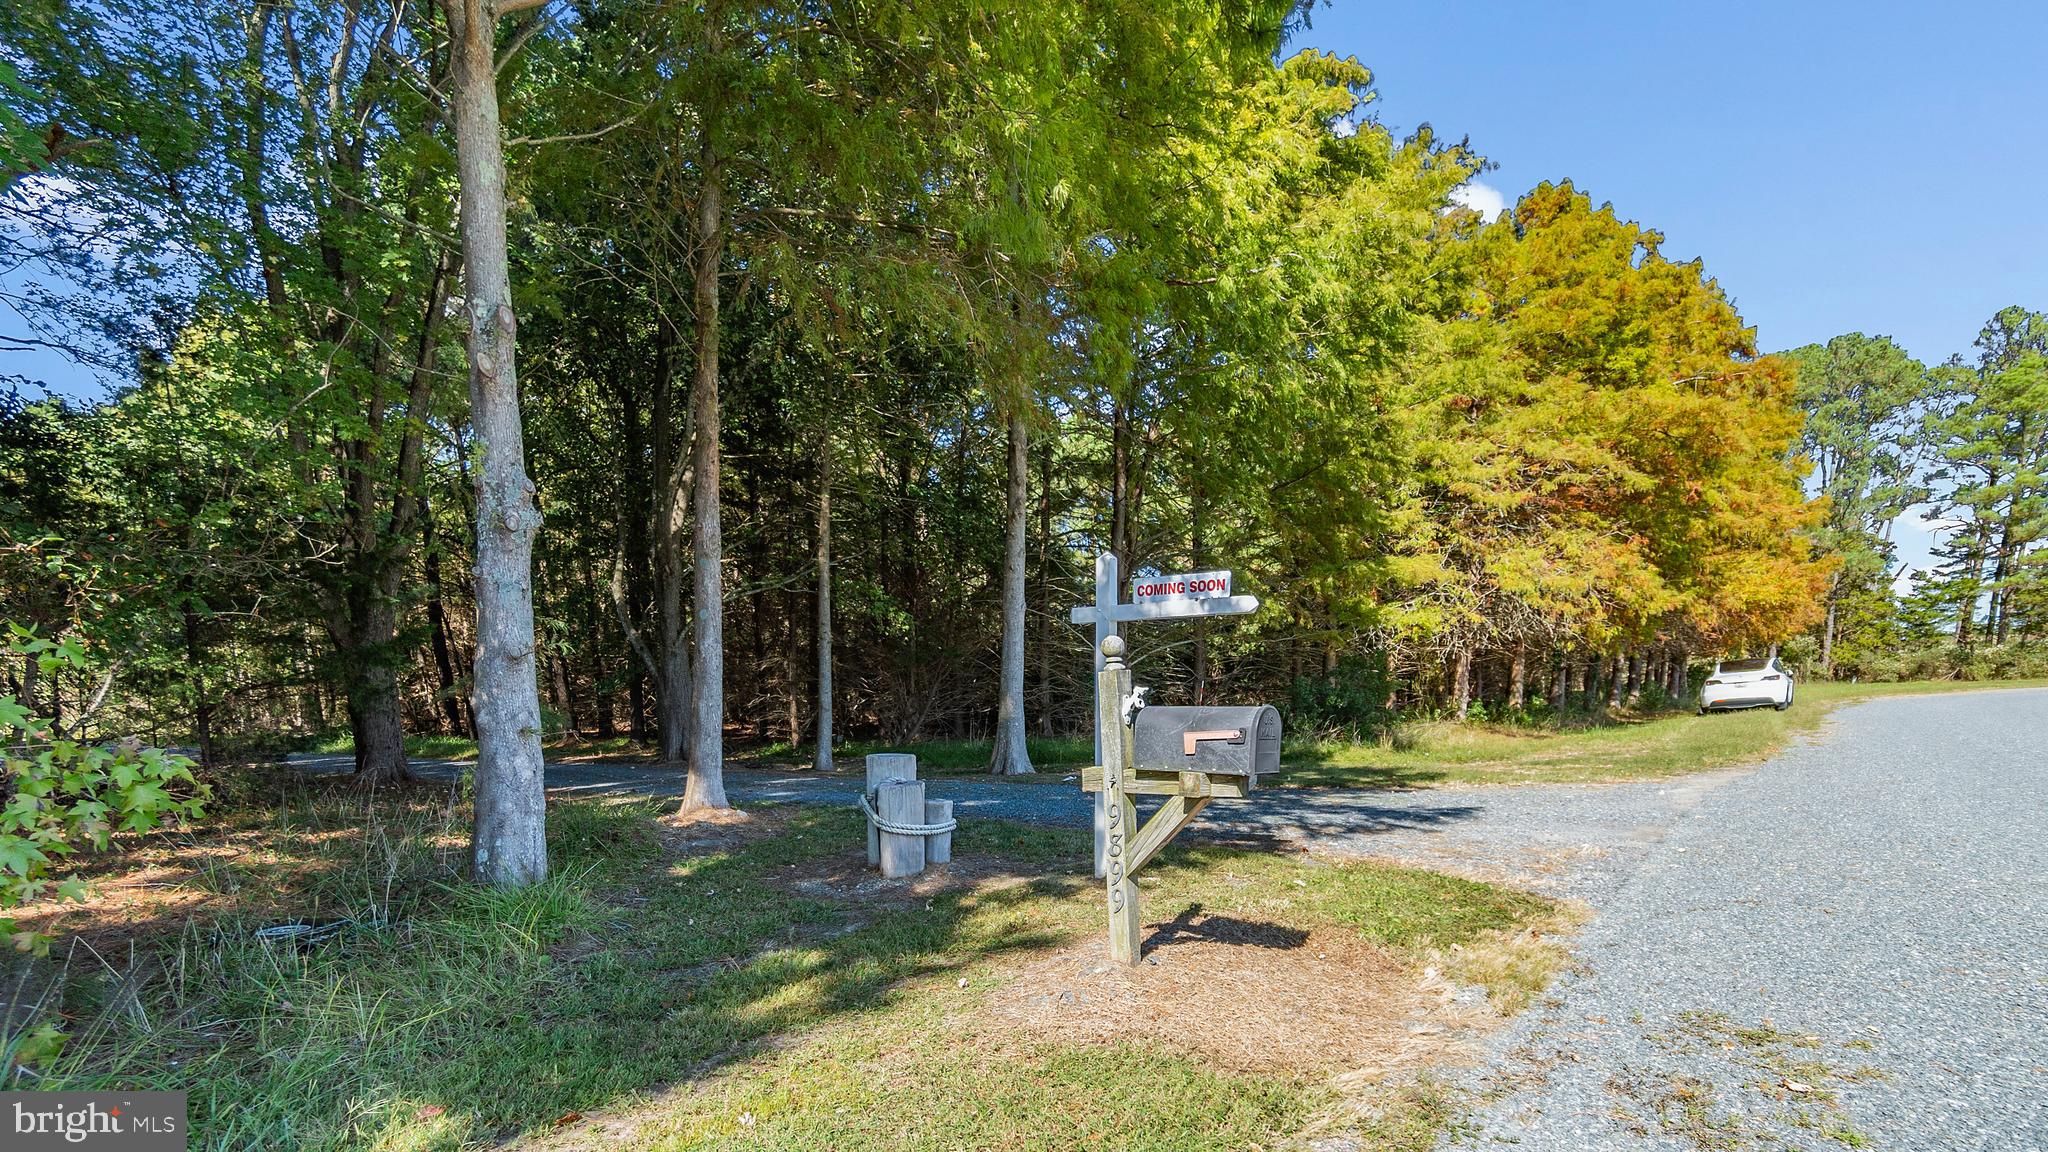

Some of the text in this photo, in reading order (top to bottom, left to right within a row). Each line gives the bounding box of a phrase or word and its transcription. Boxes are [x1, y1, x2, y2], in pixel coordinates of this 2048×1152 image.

[1137, 578, 1226, 597] COMING SOON
[1260, 727, 1276, 738] MAIL
[1107, 804, 1125, 914] 9899
